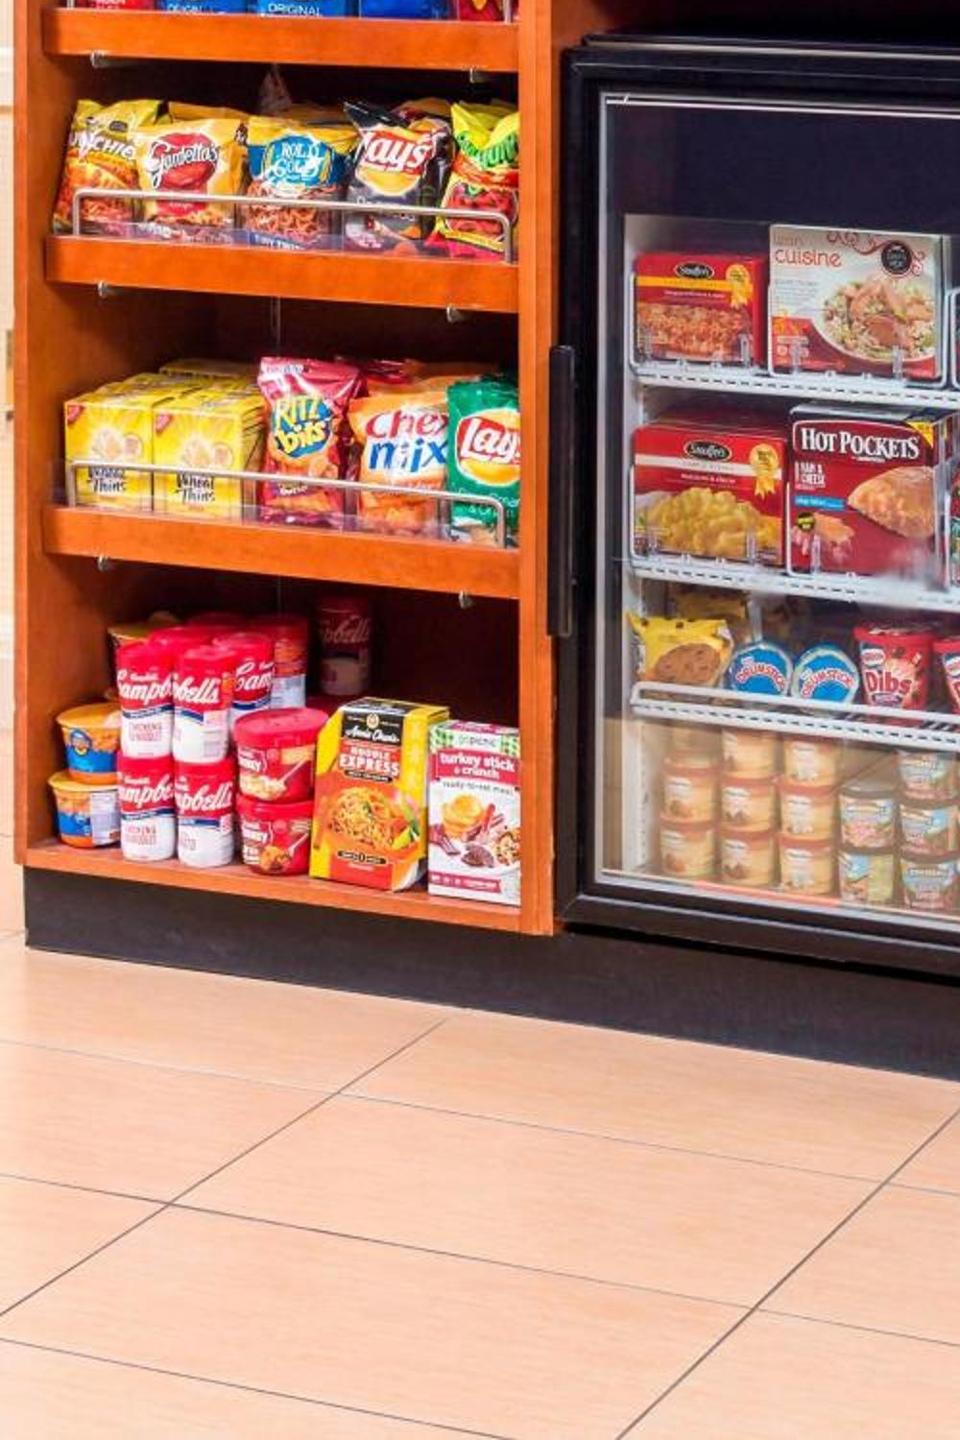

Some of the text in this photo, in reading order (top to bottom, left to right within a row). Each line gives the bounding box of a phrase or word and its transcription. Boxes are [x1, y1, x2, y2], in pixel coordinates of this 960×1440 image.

[69, 131, 135, 160] UNCHIE
[280, 141, 320, 160] ROLD
[146, 139, 219, 187] Gardetto's
[268, 158, 321, 182] GOLD
[775, 249, 843, 267] cuisine
[274, 396, 321, 424] RITZ
[369, 436, 448, 473] mix
[460, 417, 519, 465] Lay
[800, 427, 920, 459] HOT POCKETS
[174, 487, 217, 503] Thins
[117, 668, 173, 705] Campb
[173, 674, 221, 705] bell's
[865, 668, 913, 694] Dibs
[339, 753, 400, 777] EXPRESS
[440, 751, 516, 773] turkey stick
[462, 765, 500, 780] crunch
[175, 780, 234, 812] pbell's
